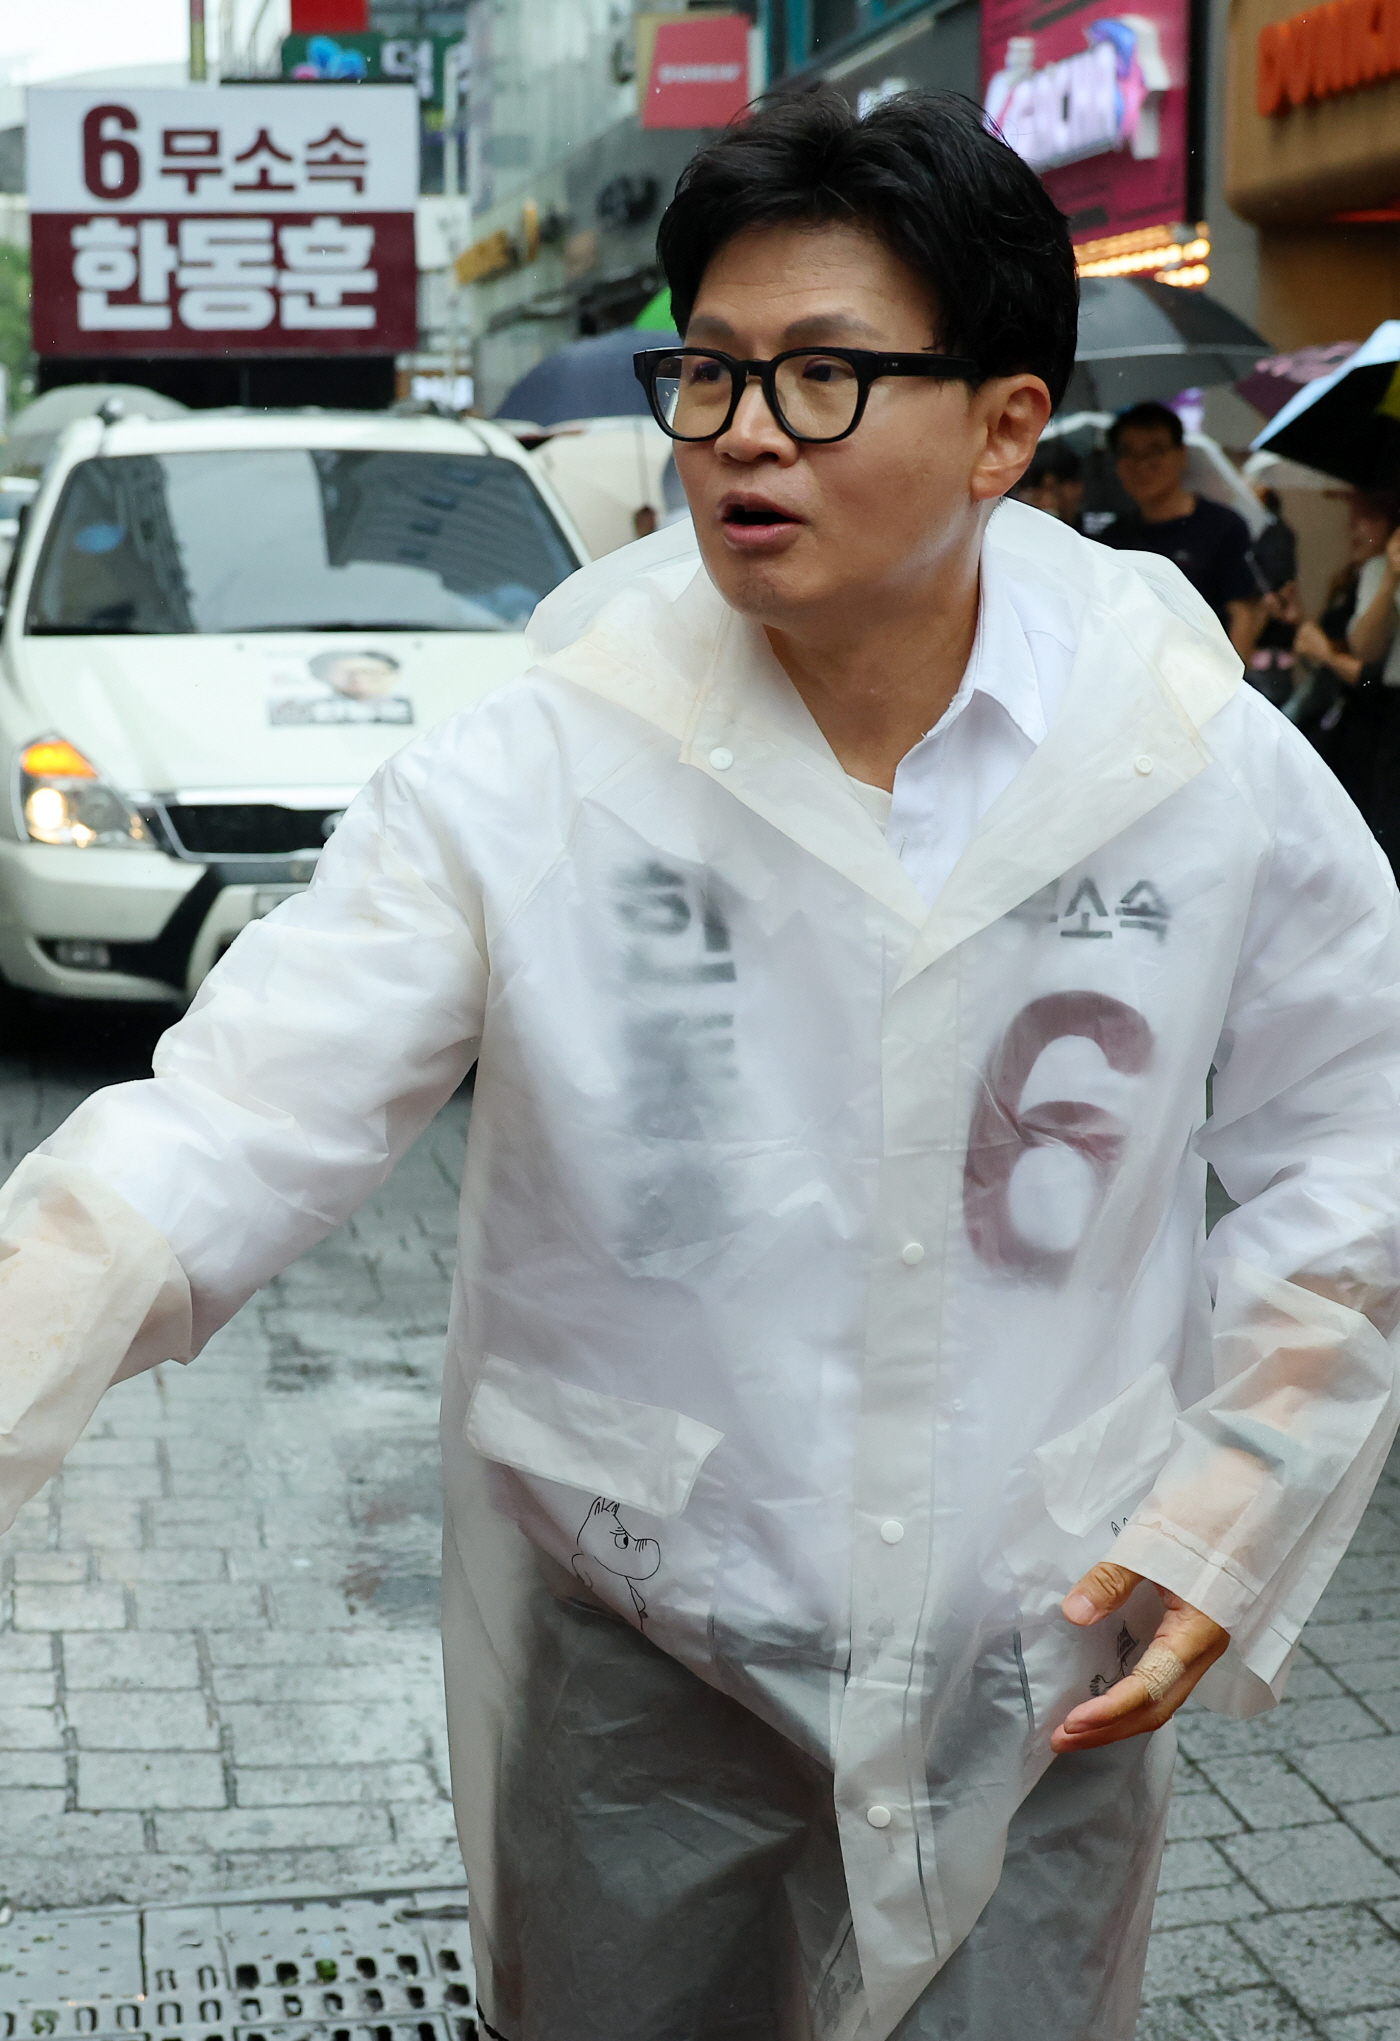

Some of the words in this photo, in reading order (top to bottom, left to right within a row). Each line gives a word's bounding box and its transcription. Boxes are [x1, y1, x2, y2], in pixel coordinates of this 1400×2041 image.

[82, 103, 141, 200] 6
[159, 126, 369, 194] 무소속
[71, 216, 378, 331] 한동훈
[962, 989, 1156, 1282] 6
